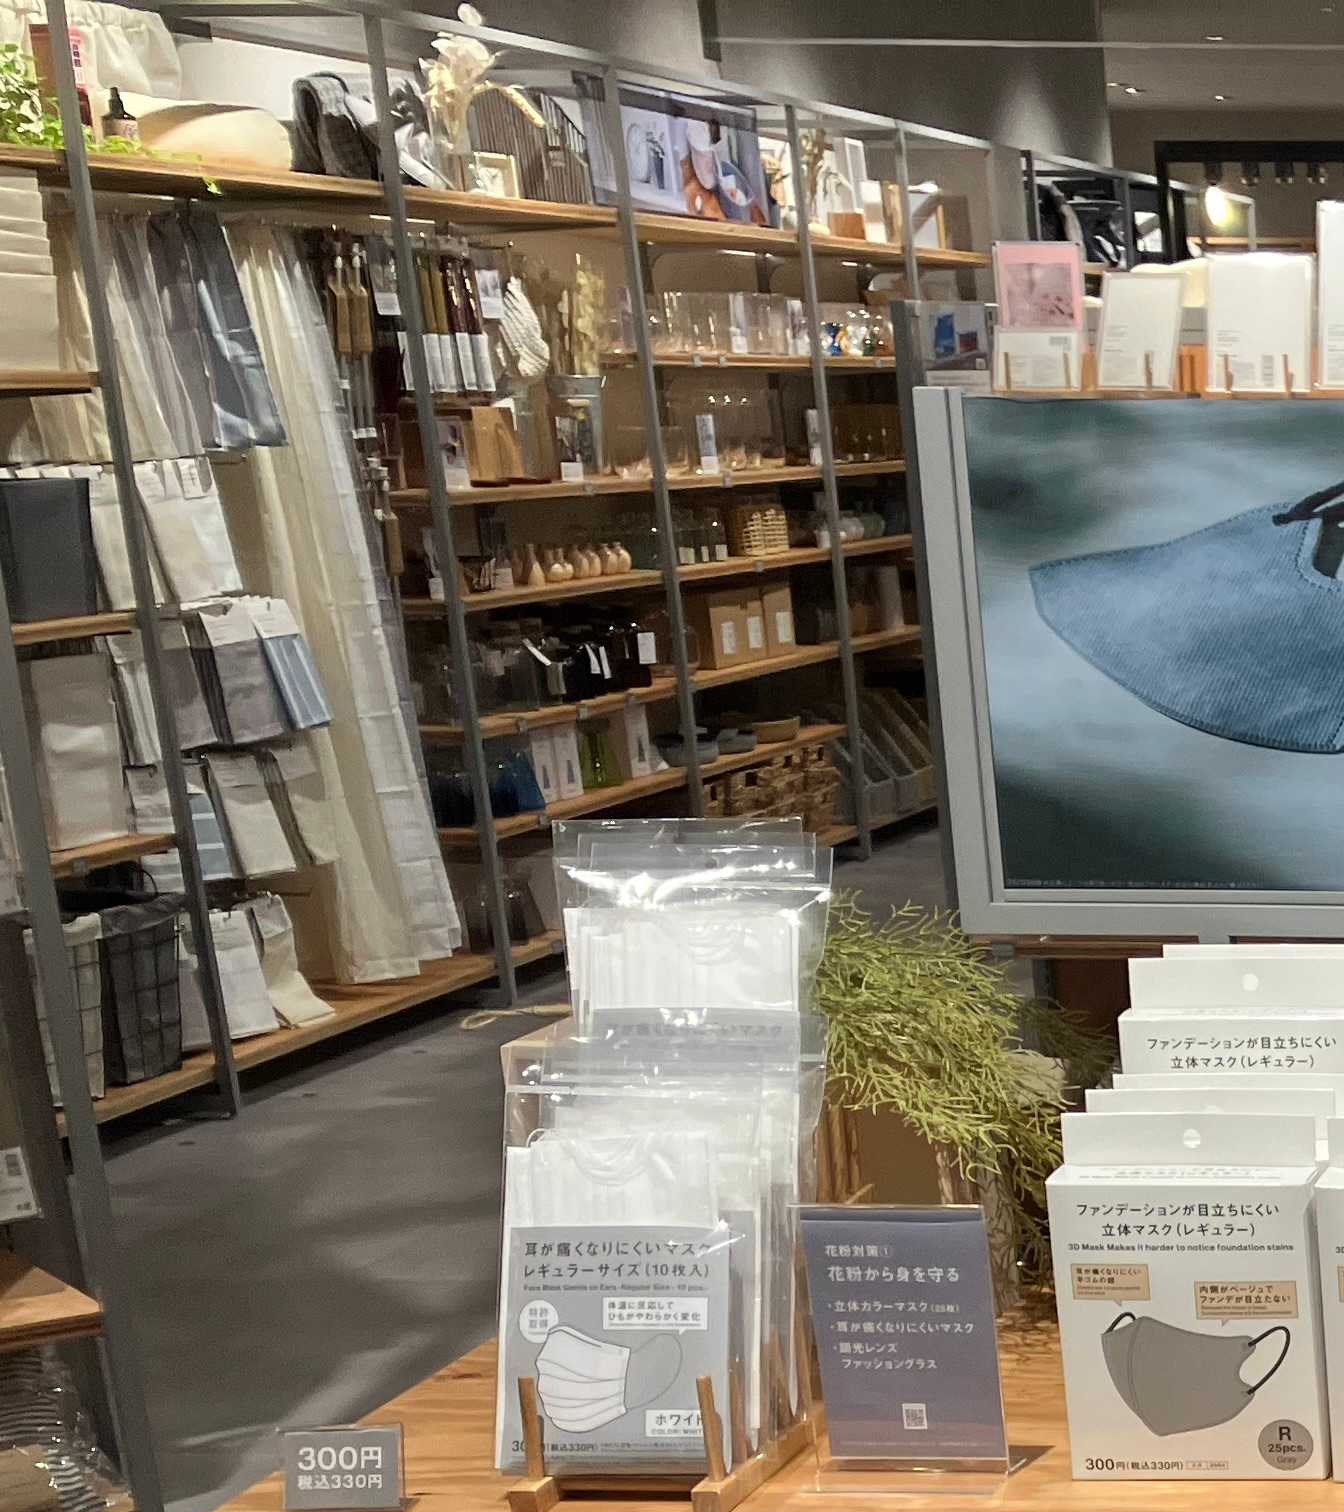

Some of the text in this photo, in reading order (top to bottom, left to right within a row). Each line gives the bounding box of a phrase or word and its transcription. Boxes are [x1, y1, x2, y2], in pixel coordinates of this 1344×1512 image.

[1147, 1036, 1337, 1051] ファンデーションが目立ちにくい
[1171, 1054, 1315, 1070] 立体マスク(レギュラー)
[1077, 1203, 1279, 1217] ファンデーションが目立ちにくい
[1102, 1223, 1255, 1237] 立体マスク(レギュラー)
[1081, 1243, 1105, 1251] Mask
[1107, 1243, 1136, 1251] Makes
[1145, 1243, 1174, 1251] harder
[1216, 1243, 1265, 1251] foundation
[524, 1264, 709, 1278] レギュラーサイズ(10枚入)
[828, 1266, 959, 1283] 花粉から身を守る
[1279, 1426, 1292, 1440] R
[298, 1446, 382, 1471] 300円
[298, 1475, 383, 1490] 税込330円
